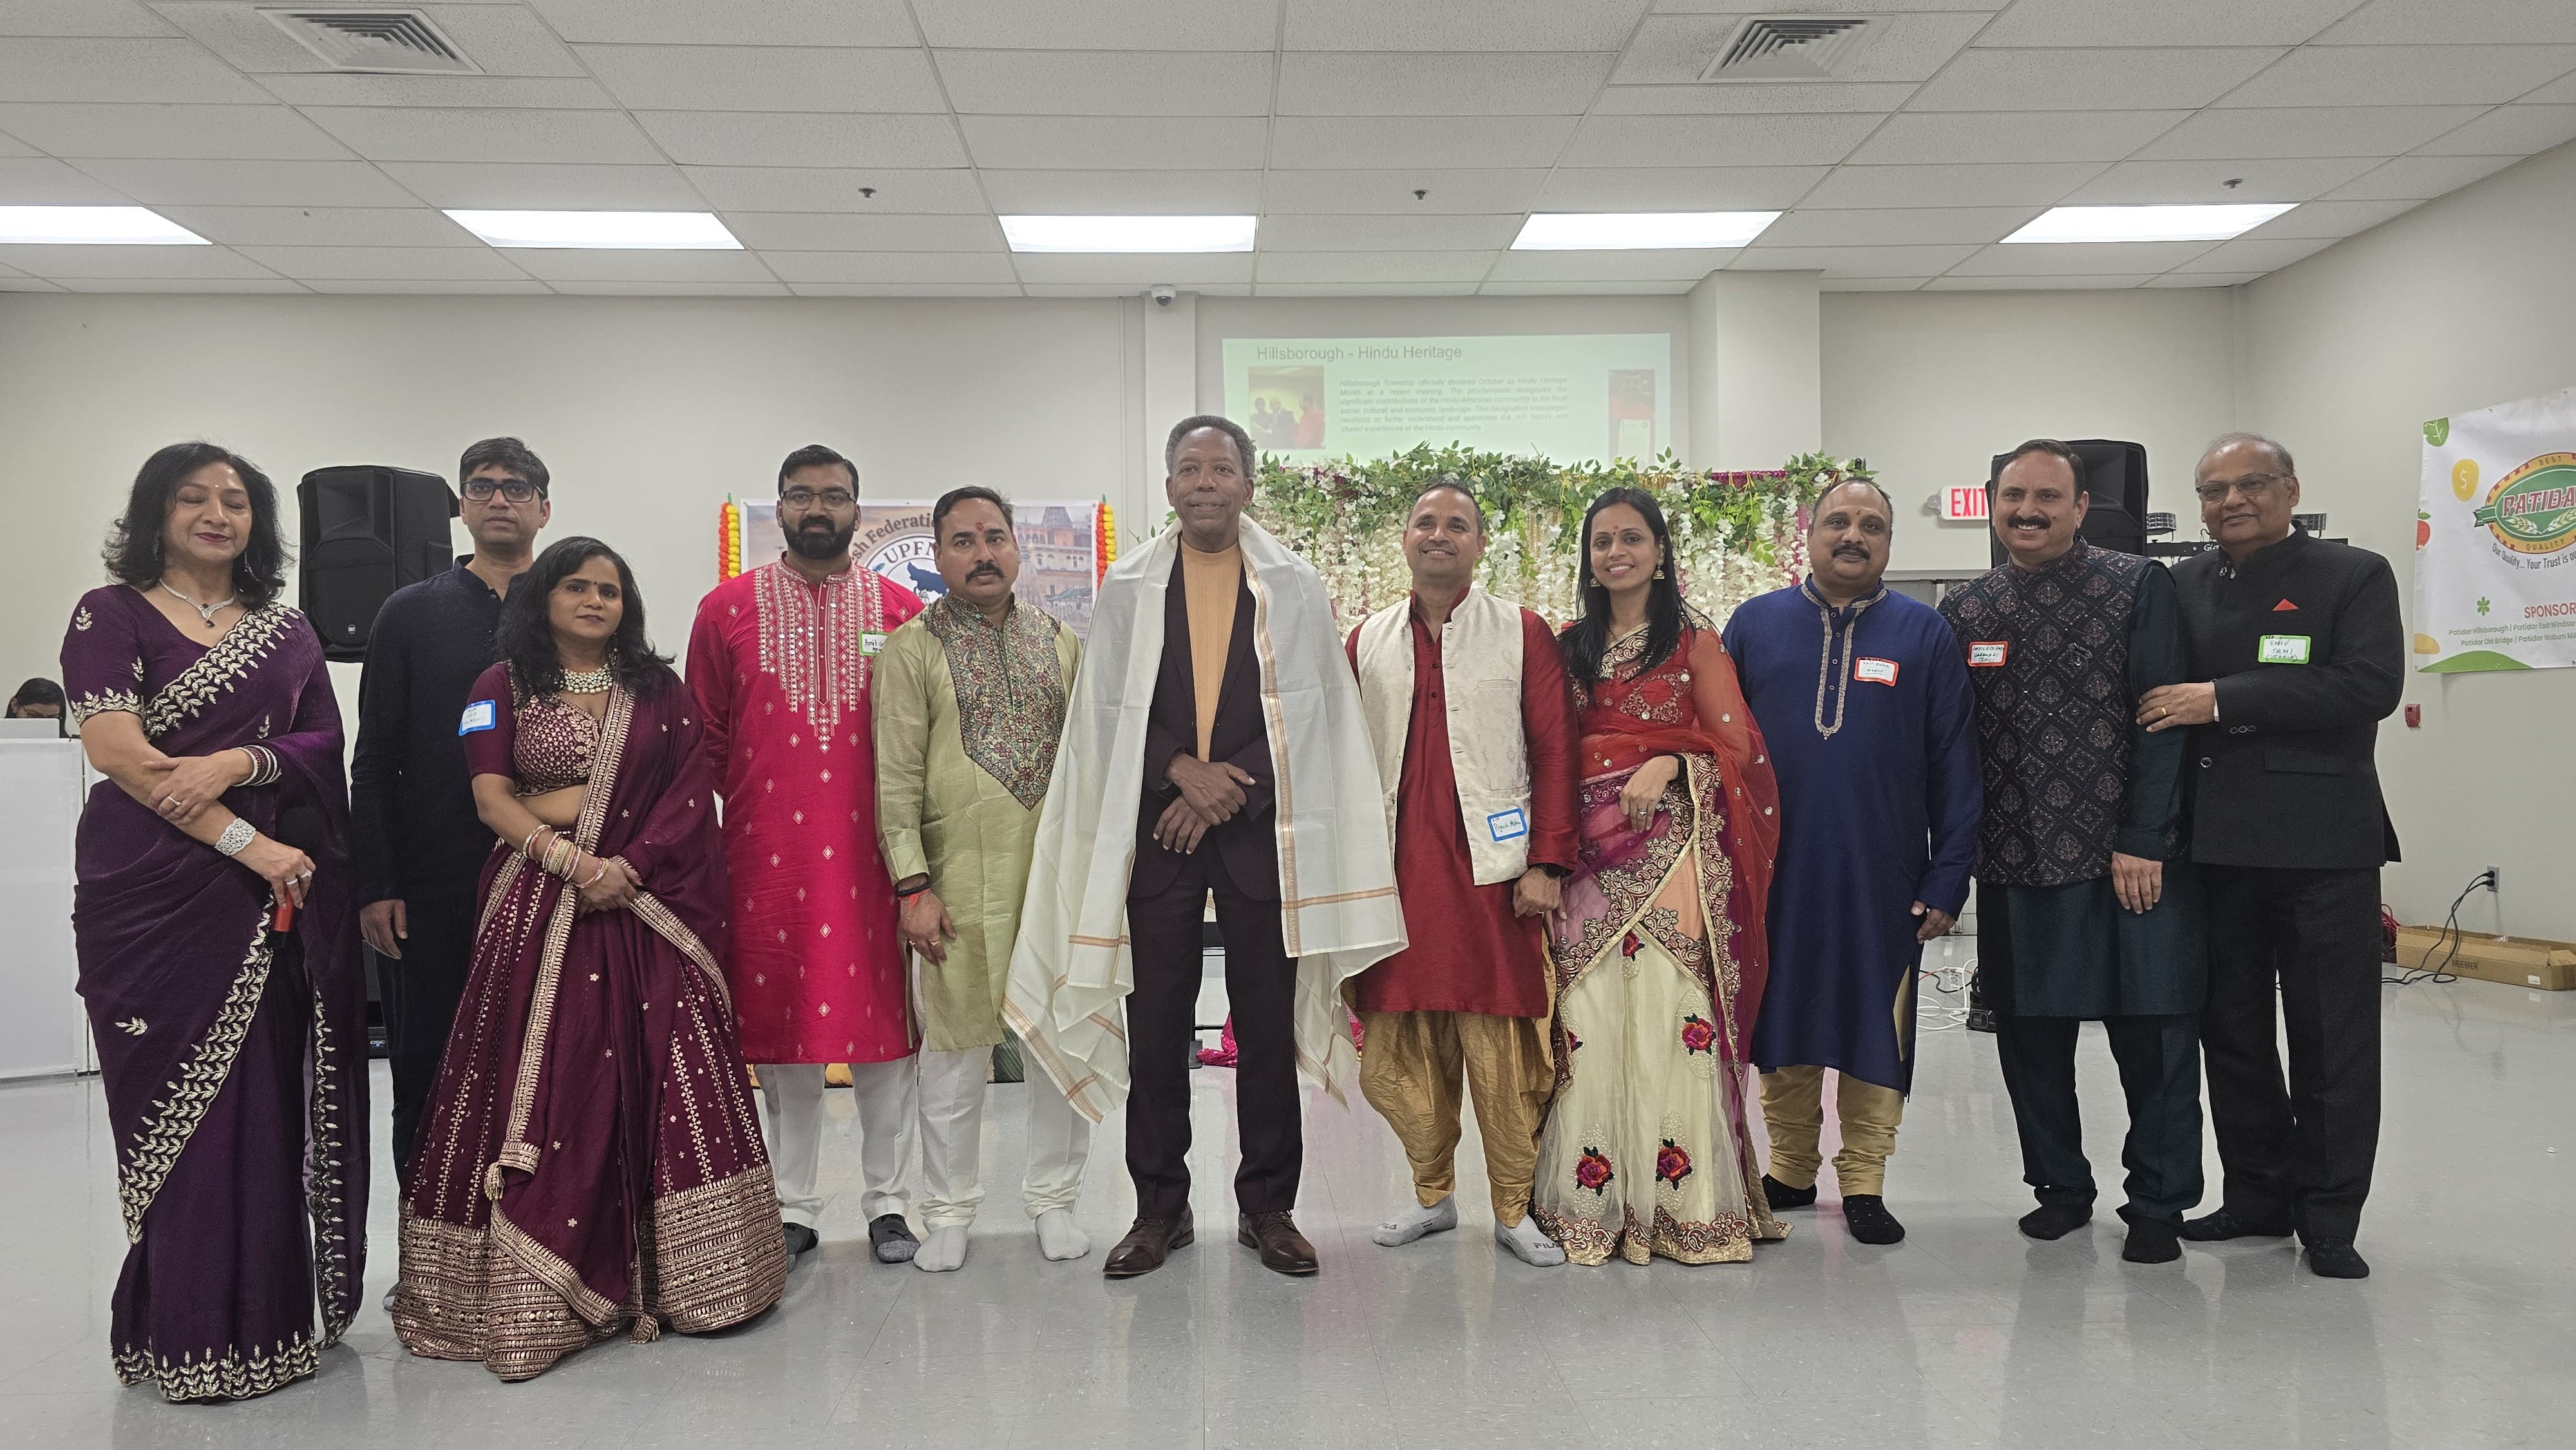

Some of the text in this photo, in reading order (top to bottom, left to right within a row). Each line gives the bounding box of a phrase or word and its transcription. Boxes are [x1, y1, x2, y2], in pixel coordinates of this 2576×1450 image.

[1257, 346, 1343, 362] Hillsborough
[1358, 346, 1398, 359] Hindu
[1403, 345, 1462, 361] Heritage
[2539, 456, 2562, 466] BEST
[1951, 488, 1986, 516] EXIT
[865, 513, 934, 546] Federati
[2526, 538, 2565, 551] QUALITY
[2492, 543, 2501, 556] Our
[2526, 558, 2541, 569] Your
[2543, 554, 2561, 569] Trust
[2562, 554, 2568, 565] is
[2524, 602, 2576, 618] SPONSOR
[2448, 628, 2472, 636] Patidar
[2473, 625, 2508, 634] Hillsborough
[2550, 620, 2576, 628] Windsor
[2494, 637, 2514, 645] Bridge
[2519, 634, 2543, 643] Patidar
[2452, 959, 2479, 970] NEEWER
